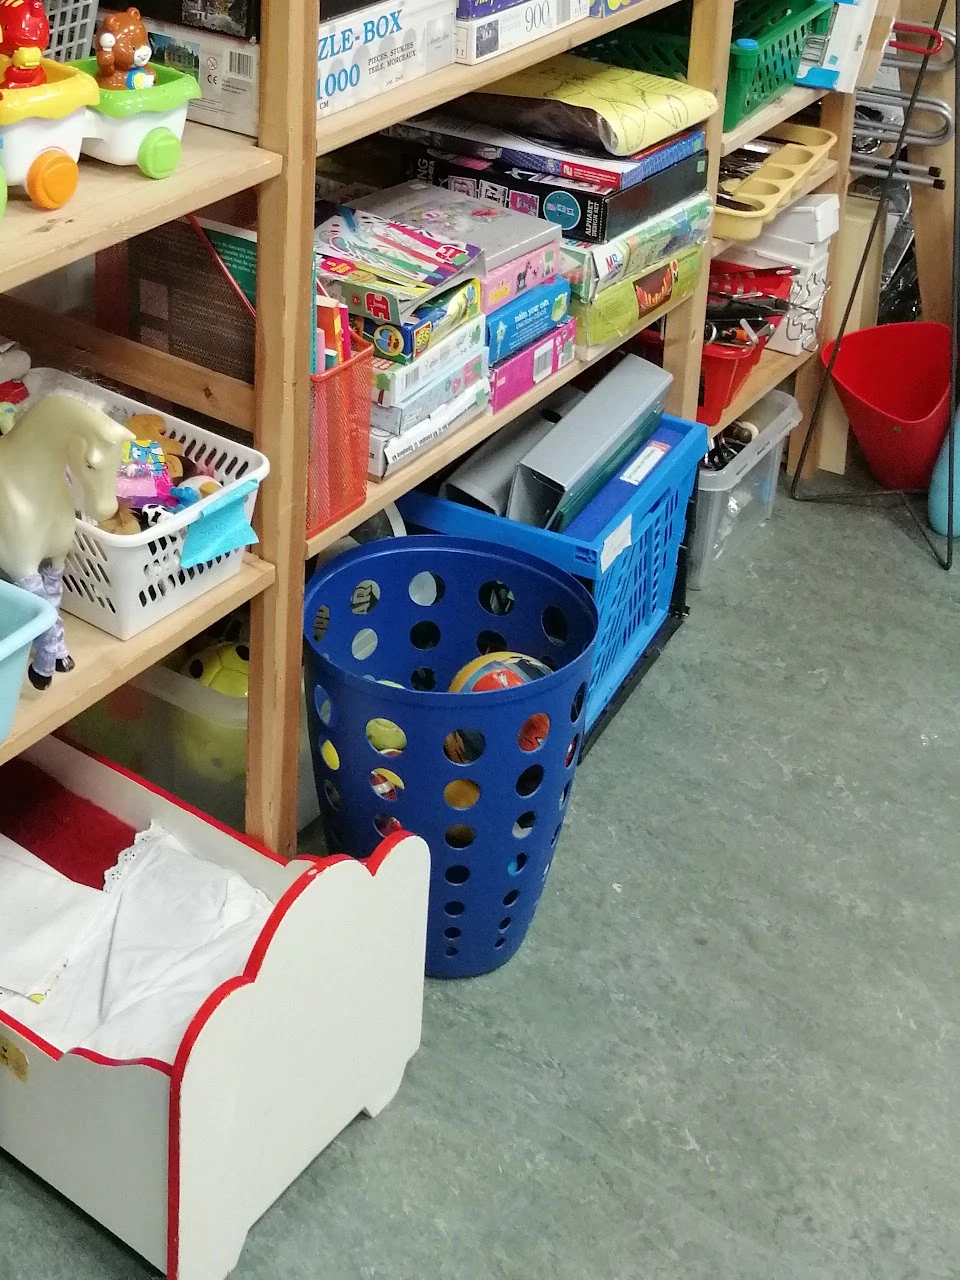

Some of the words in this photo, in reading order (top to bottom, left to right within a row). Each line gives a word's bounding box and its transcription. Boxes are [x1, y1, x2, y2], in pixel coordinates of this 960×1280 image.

[524, 0, 551, 33] 900
[367, 52, 388, 67] PIECES,
[389, 41, 414, 56] STUKJES
[368, 62, 385, 76] TEILE,
[385, 49, 417, 70] MORCEAUX
[317, 63, 361, 101] 1000
[319, 100, 329, 110] CM
[585, 199, 595, 237] ALPHABET
[592, 201, 600, 219] SET
[591, 219, 600, 238] DESIGN
